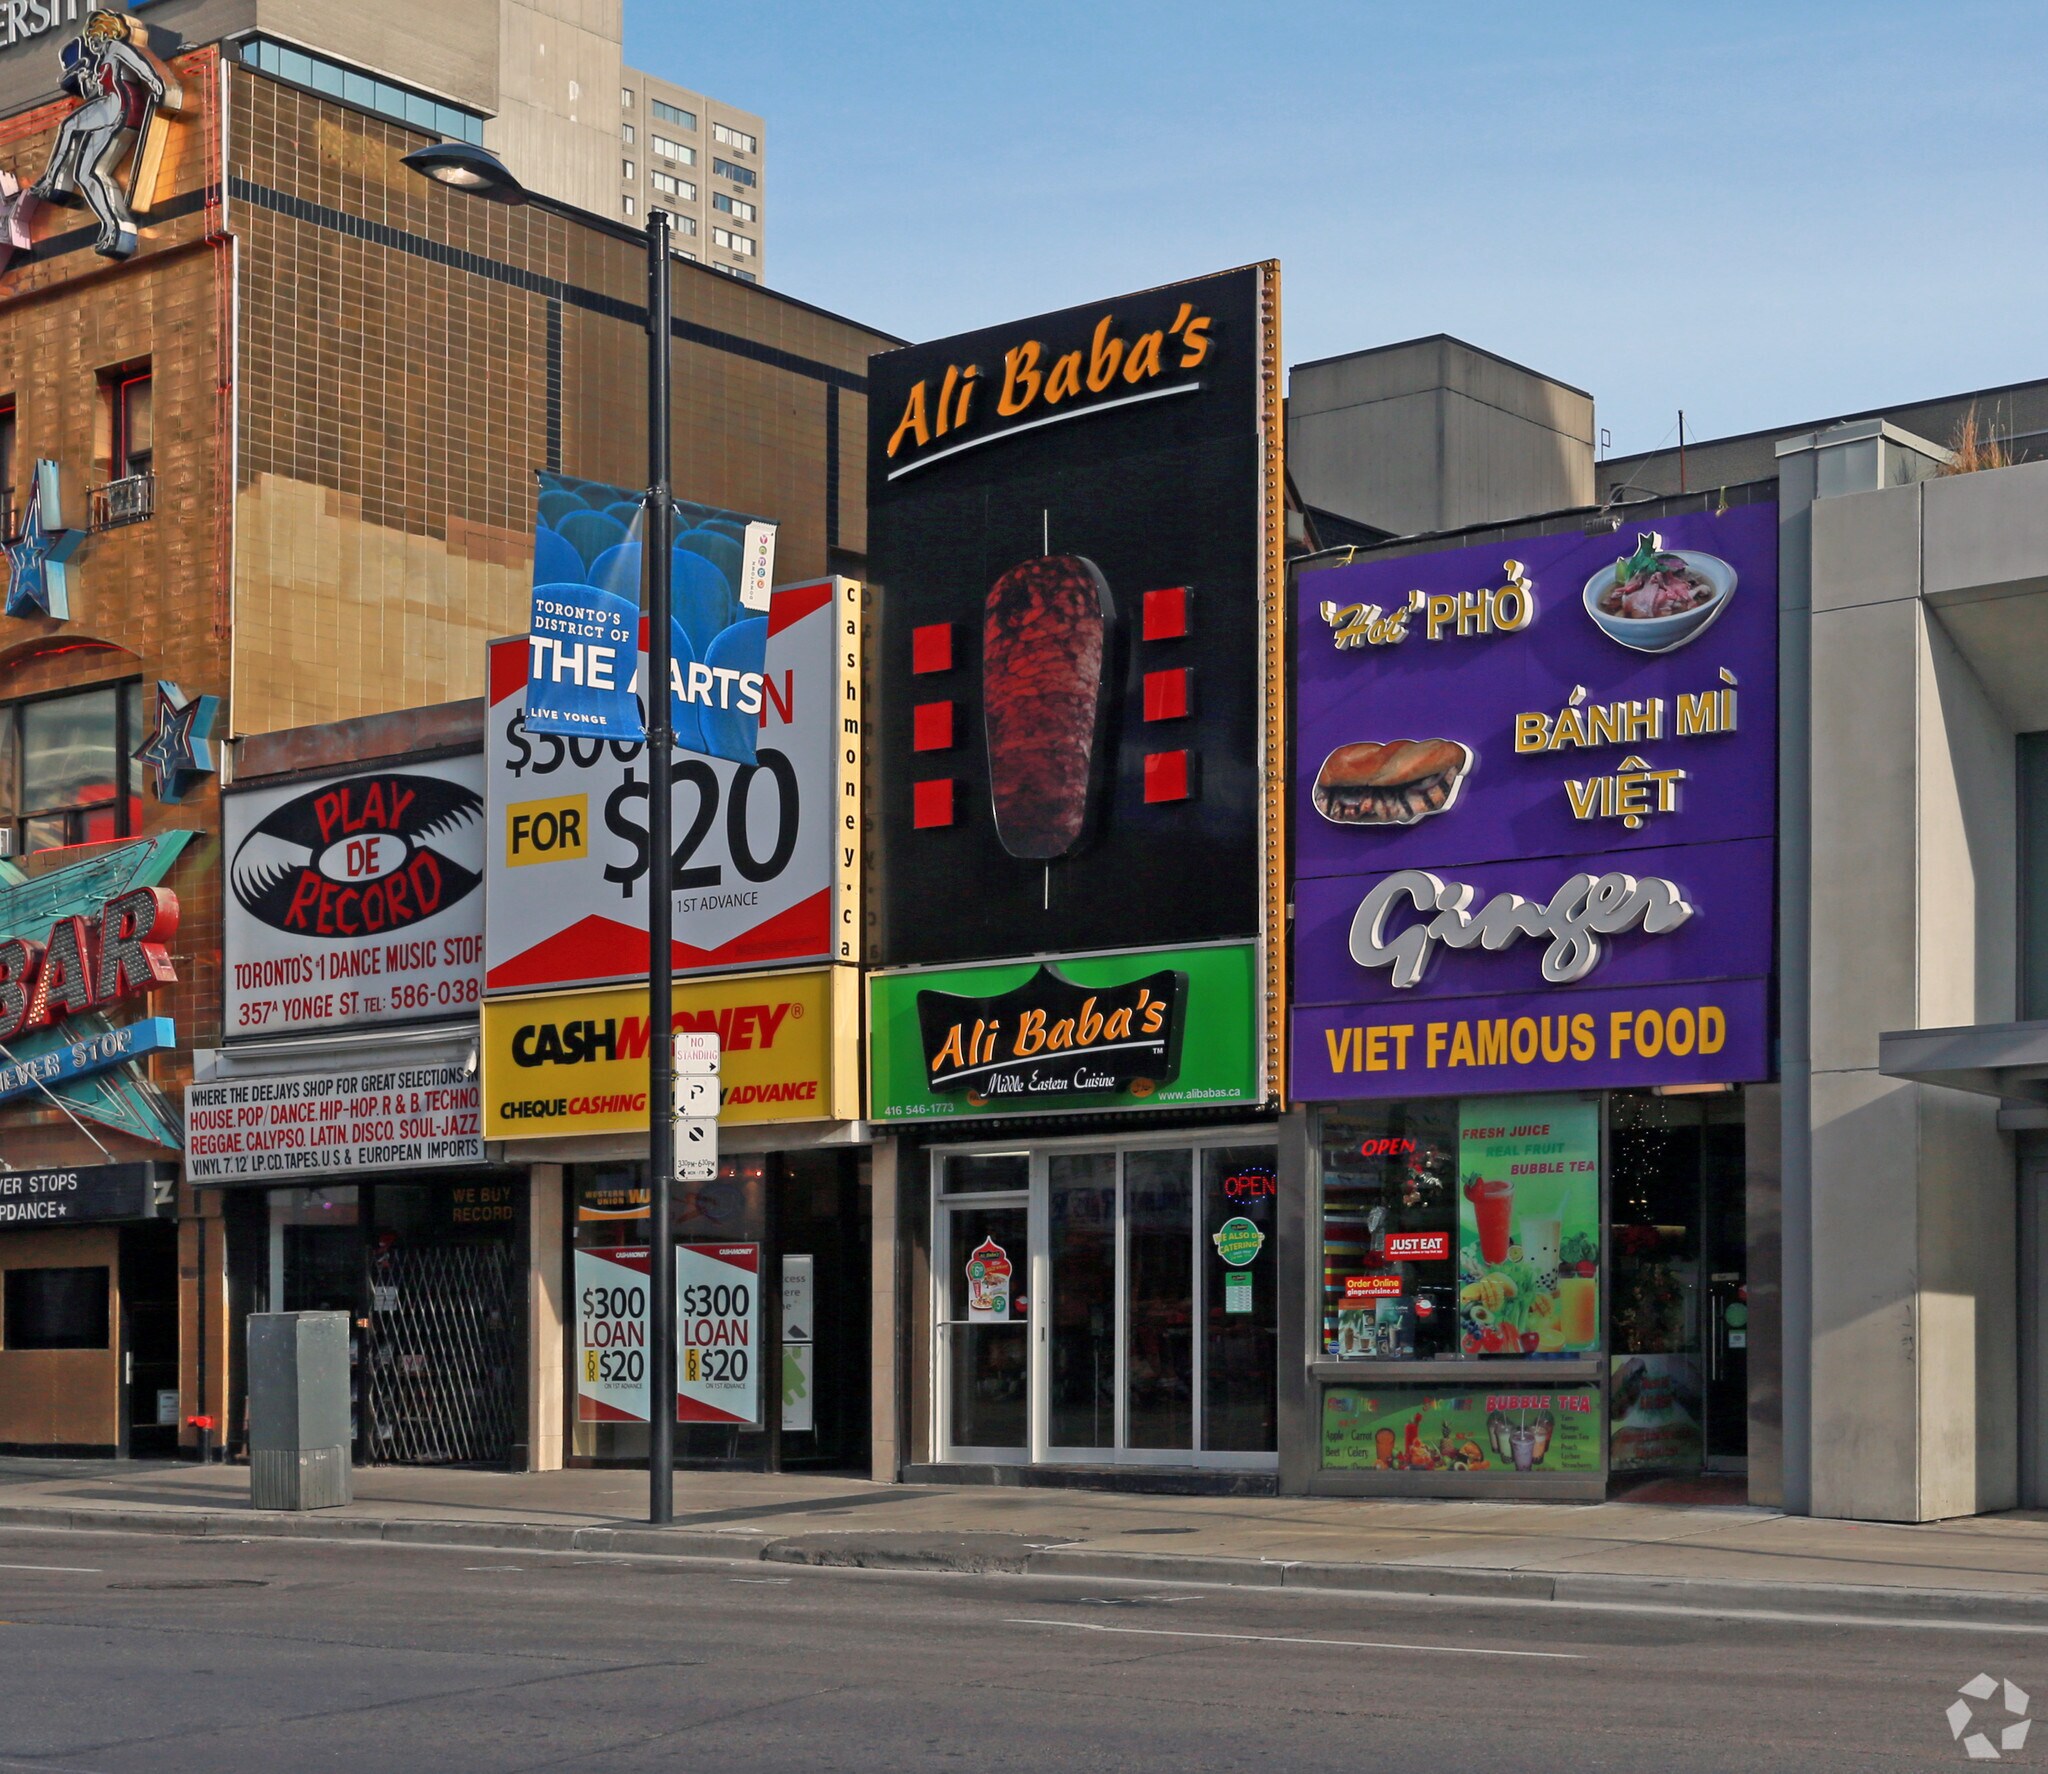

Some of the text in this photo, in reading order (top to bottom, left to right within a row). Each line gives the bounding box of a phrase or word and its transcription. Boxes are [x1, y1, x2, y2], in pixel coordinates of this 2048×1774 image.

[887, 303, 1212, 458] Ali Baba's
[536, 599, 621, 625] TORONTO'S
[535, 616, 630, 642] DISTRICT OF
[529, 635, 616, 690] THE
[531, 708, 607, 724] LIVE YONGE
[1515, 667, 1738, 754] BÁNH MÌ
[1564, 756, 1686, 829] VIỆT
[314, 781, 416, 844] PLAY
[603, 748, 800, 899] $20
[512, 809, 581, 855] FOR
[346, 837, 381, 877] DE
[284, 851, 442, 935] RECORD
[677, 892, 759, 913] 1ST ADVANCE
[1349, 870, 1694, 988] Ginger
[234, 953, 313, 991] TORONTO'S
[330, 947, 381, 980] DANCE
[386, 940, 436, 974] MUSIC
[283, 995, 333, 1022] YONGE
[340, 991, 360, 1016] ST.
[364, 997, 386, 1014] TEL:
[391, 977, 482, 1010] 586-038
[690, 1037, 704, 1048] NO
[932, 989, 1167, 1072] Ali Baba's
[1325, 1006, 1726, 1073] VIET FAMOUS FOOD
[72, 1028, 132, 1068] STOP
[677, 1050, 718, 1061] STANDING
[192, 1089, 227, 1107] WHERE
[230, 1087, 249, 1104] THE
[252, 1082, 300, 1102] DEEJAYS
[303, 1079, 333, 1098] SHOP
[336, 1077, 358, 1094] FOR
[361, 1073, 396, 1092] GREAT
[398, 1066, 464, 1089] SELECTIONS
[727, 1081, 818, 1105] ADVANCE
[981, 1073, 1024, 1097] Middle
[1028, 1069, 1068, 1092] Eastern
[1073, 1067, 1115, 1089] Cuisine
[1158, 1088, 1241, 1100] www.alibabas.ca
[382, 1096, 391, 1115] R
[395, 1094, 406, 1115] &
[500, 1098, 567, 1119] CHEQUE
[568, 1093, 647, 1116] CASHING
[885, 1103, 954, 1116] 416 546-1773
[1361, 1137, 1417, 1157] OPEN
[1462, 1124, 1550, 1139] FRESH JUICE
[192, 1158, 221, 1176] VINYL
[359, 1143, 422, 1164] EUROPEAN
[428, 1139, 479, 1159] IMPORTS
[1486, 1142, 1565, 1157] REAL FRUIT
[29, 1173, 78, 1193] STOPS
[1511, 1160, 1595, 1175] BUBBLE TEA
[1224, 1176, 1277, 1196] OPEN
[1390, 1238, 1443, 1250] JUST EAT
[1347, 1279, 1400, 1288] Order Online
[583, 1286, 645, 1319] $300
[683, 1284, 750, 1317] $300
[584, 1321, 644, 1347] LOAN
[684, 1319, 749, 1346] LOAN
[587, 1350, 596, 1382] FOR
[600, 1350, 645, 1382] $20
[687, 1349, 696, 1382] FOR
[701, 1349, 748, 1382] $20
[1485, 1395, 1552, 1413] BUBBLE
[1558, 1395, 1592, 1414] TEA
